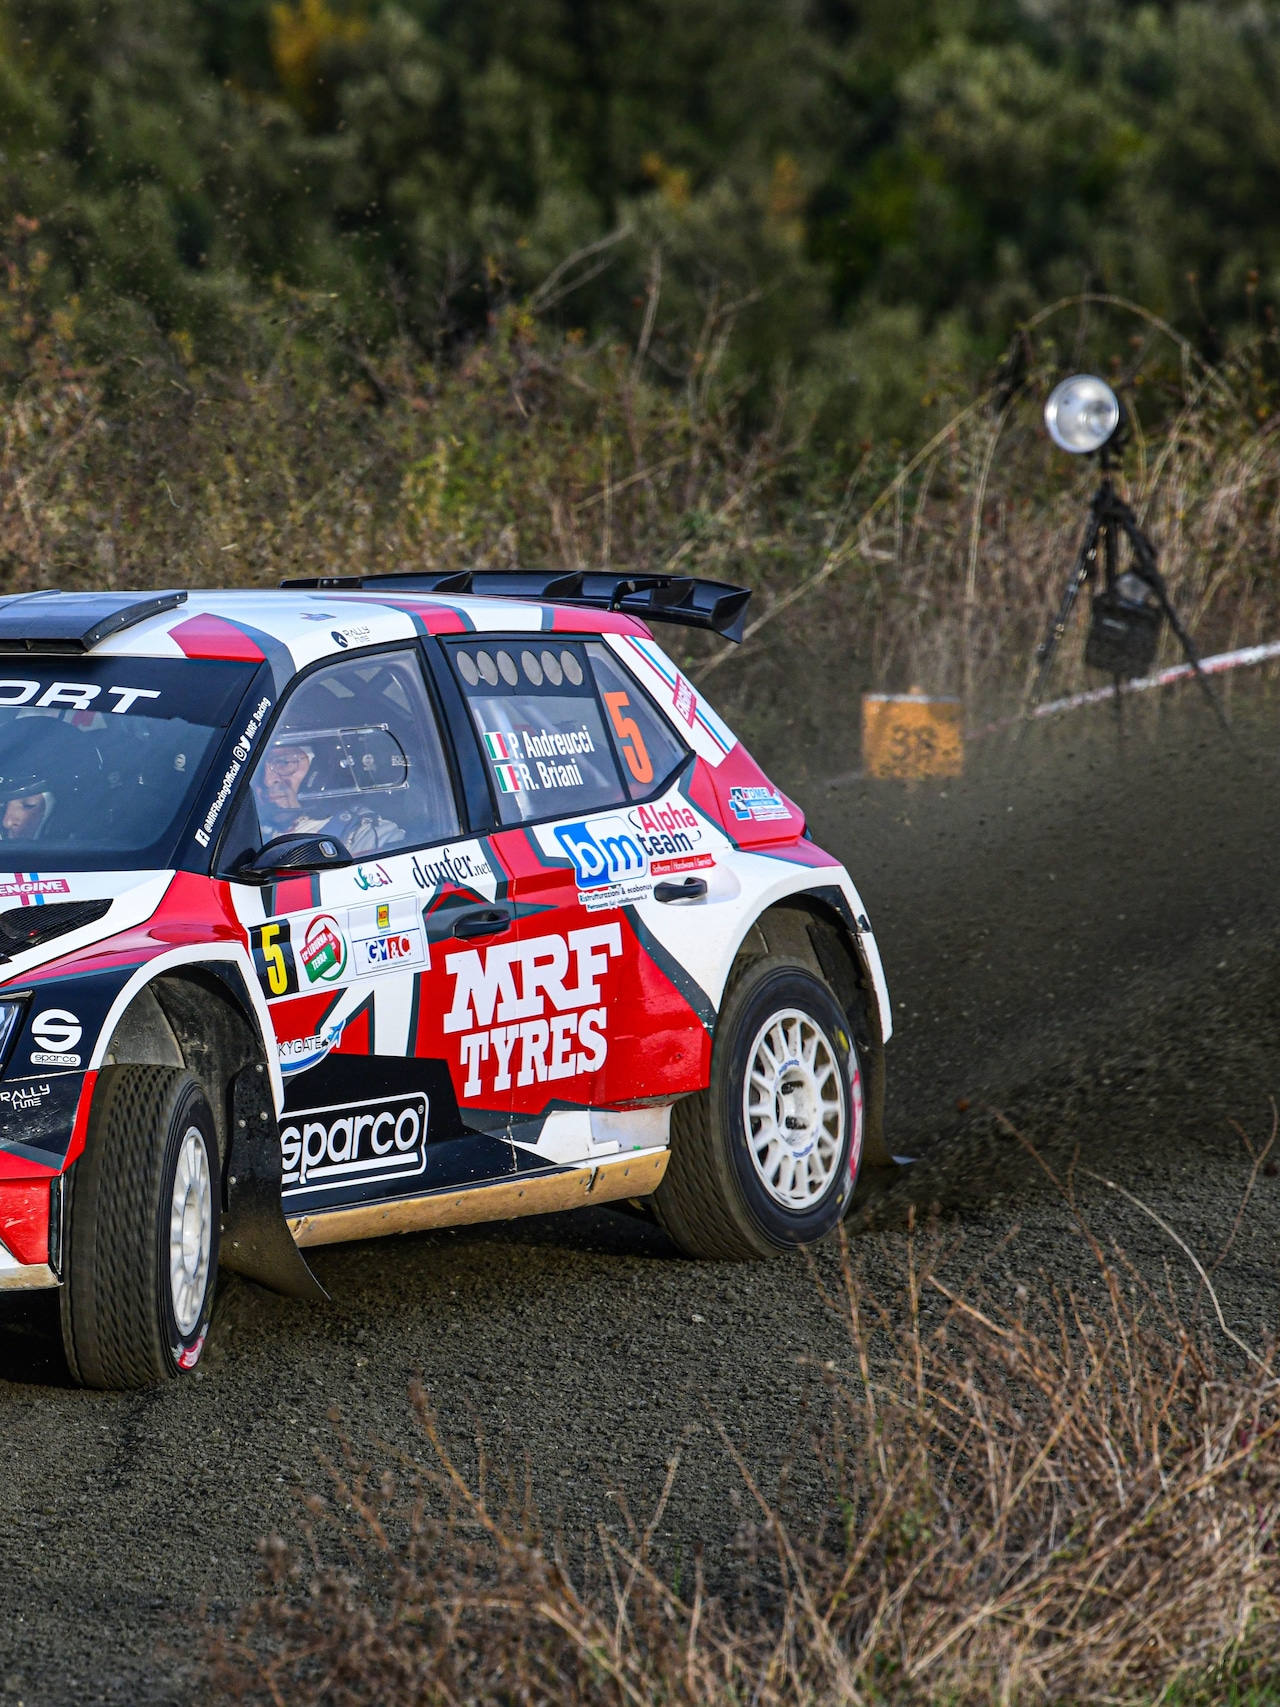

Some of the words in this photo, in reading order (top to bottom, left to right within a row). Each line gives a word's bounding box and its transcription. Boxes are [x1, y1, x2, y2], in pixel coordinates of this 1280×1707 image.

[342, 626, 371, 636] RALLY
[245, 697, 272, 740] MRF_Racing
[507, 732, 524, 759] P.
[522, 725, 595, 759] Andreucci
[603, 691, 655, 785] 5
[520, 764, 540, 791] R.
[536, 758, 584, 789] Briani
[637, 802, 699, 836] Alpha
[561, 833, 643, 879] bm
[635, 829, 694, 857] team
[411, 847, 492, 889] danfer.net
[580, 887, 620, 902] Ristrutturazioni
[627, 883, 653, 894] ecobonus
[261, 924, 288, 995] 5
[366, 935, 412, 963] GM&C
[443, 922, 624, 1034] MRF
[35, 1054, 77, 1064] sparco
[277, 1037, 322, 1057] KYGATE
[460, 1006, 608, 1098] TYRES
[0, 1084, 51, 1102] RALLY
[281, 1108, 421, 1184] sparco
